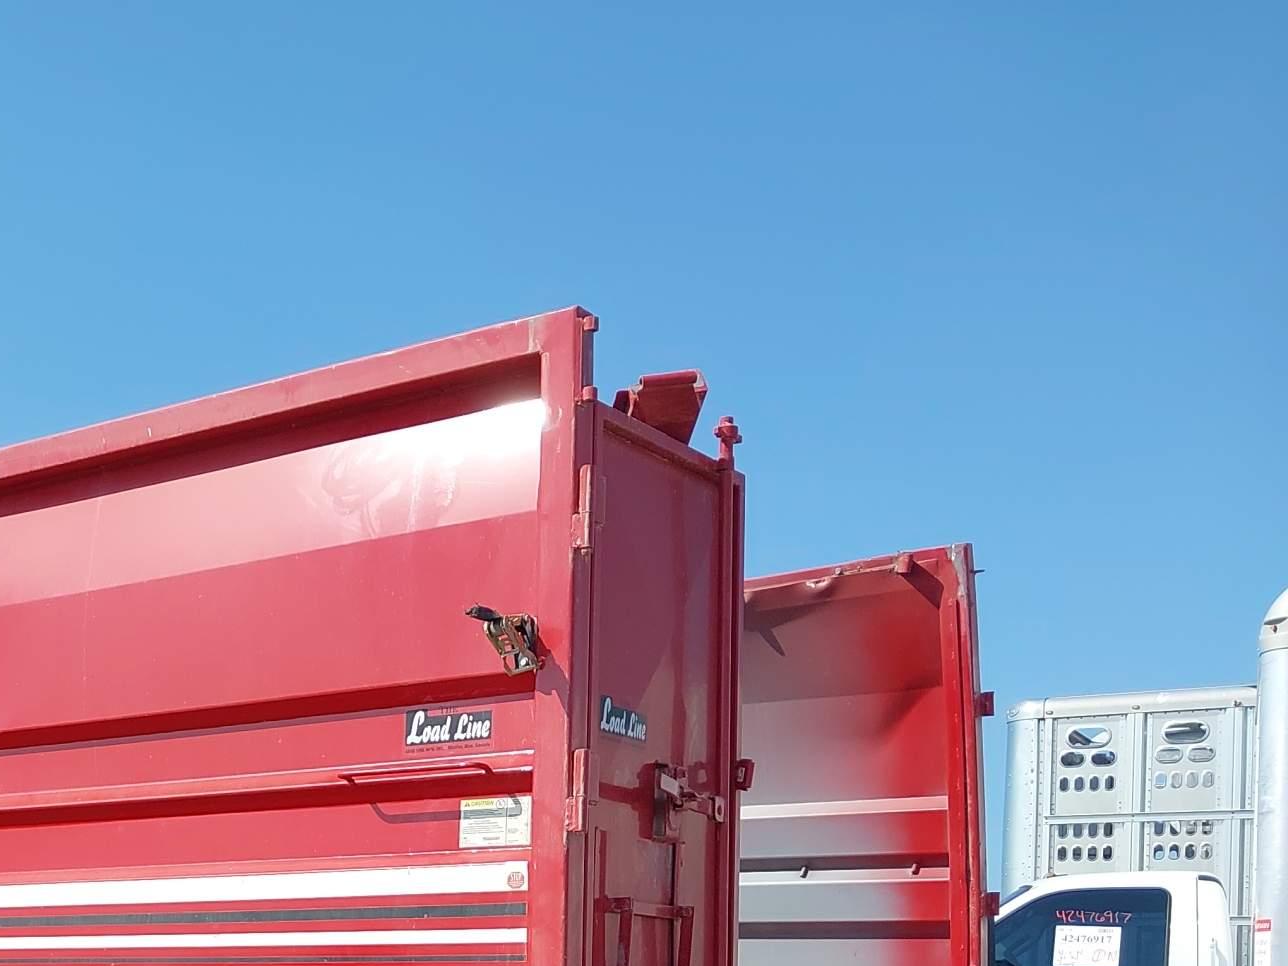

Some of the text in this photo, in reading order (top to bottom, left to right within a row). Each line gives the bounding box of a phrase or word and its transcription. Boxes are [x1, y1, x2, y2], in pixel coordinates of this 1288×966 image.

[406, 710, 491, 745] Load Line
[600, 697, 647, 741] Load Line
[1055, 910, 1132, 924] 42476917
